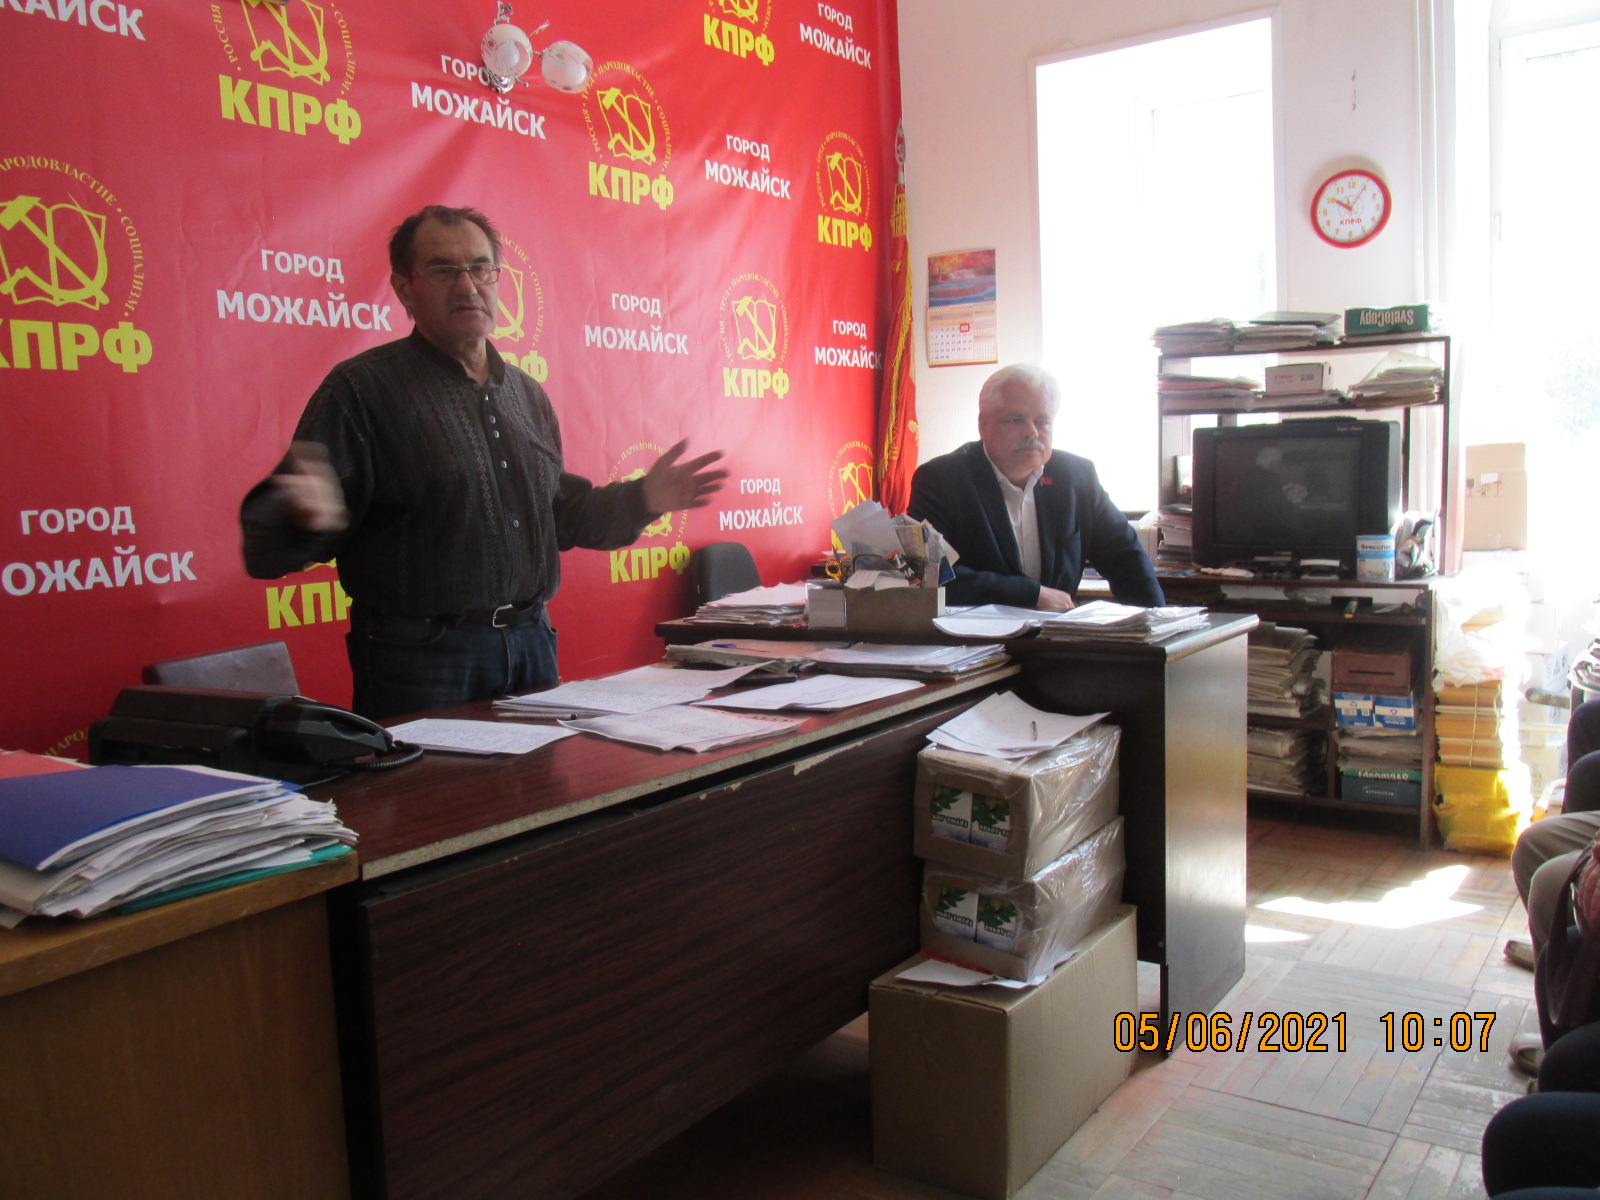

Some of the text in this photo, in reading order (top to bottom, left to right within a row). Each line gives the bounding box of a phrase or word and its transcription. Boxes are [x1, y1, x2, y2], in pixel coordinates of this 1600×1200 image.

[818, 3, 853, 33] ГОРОД
[703, 12, 775, 67] КПРФ
[799, 23, 872, 70] МОЖАЙСК
[441, 55, 491, 86] ГОРО
[218, 73, 362, 145] КПРФ
[410, 81, 547, 140] МОЖАЙСК
[725, 134, 771, 163] ГОРОД
[587, 161, 674, 211] КПРФ
[704, 159, 792, 200] МОЖАЙСК
[0, 155, 145, 311] АРОДОВЛАСТИЕ СОЦИАЛИЗМ
[817, 214, 873, 252] КПРФ
[260, 249, 345, 284] ГОРОД
[216, 289, 393, 332] МОЖАЙСК
[611, 292, 662, 319] ГОРОД
[584, 325, 689, 355] МОЖАЙСК
[832, 319, 867, 340] ГОРОД
[814, 345, 882, 370] МОЖАЙСК
[722, 366, 790, 399] КПРФ
[740, 477, 782, 496] ГОРОД
[20, 505, 136, 535] ГОРОД
[719, 501, 804, 532] МОЖАЙСК
[1, 545, 198, 597] ОЖАЙСК
[609, 540, 691, 585] КПРФ
